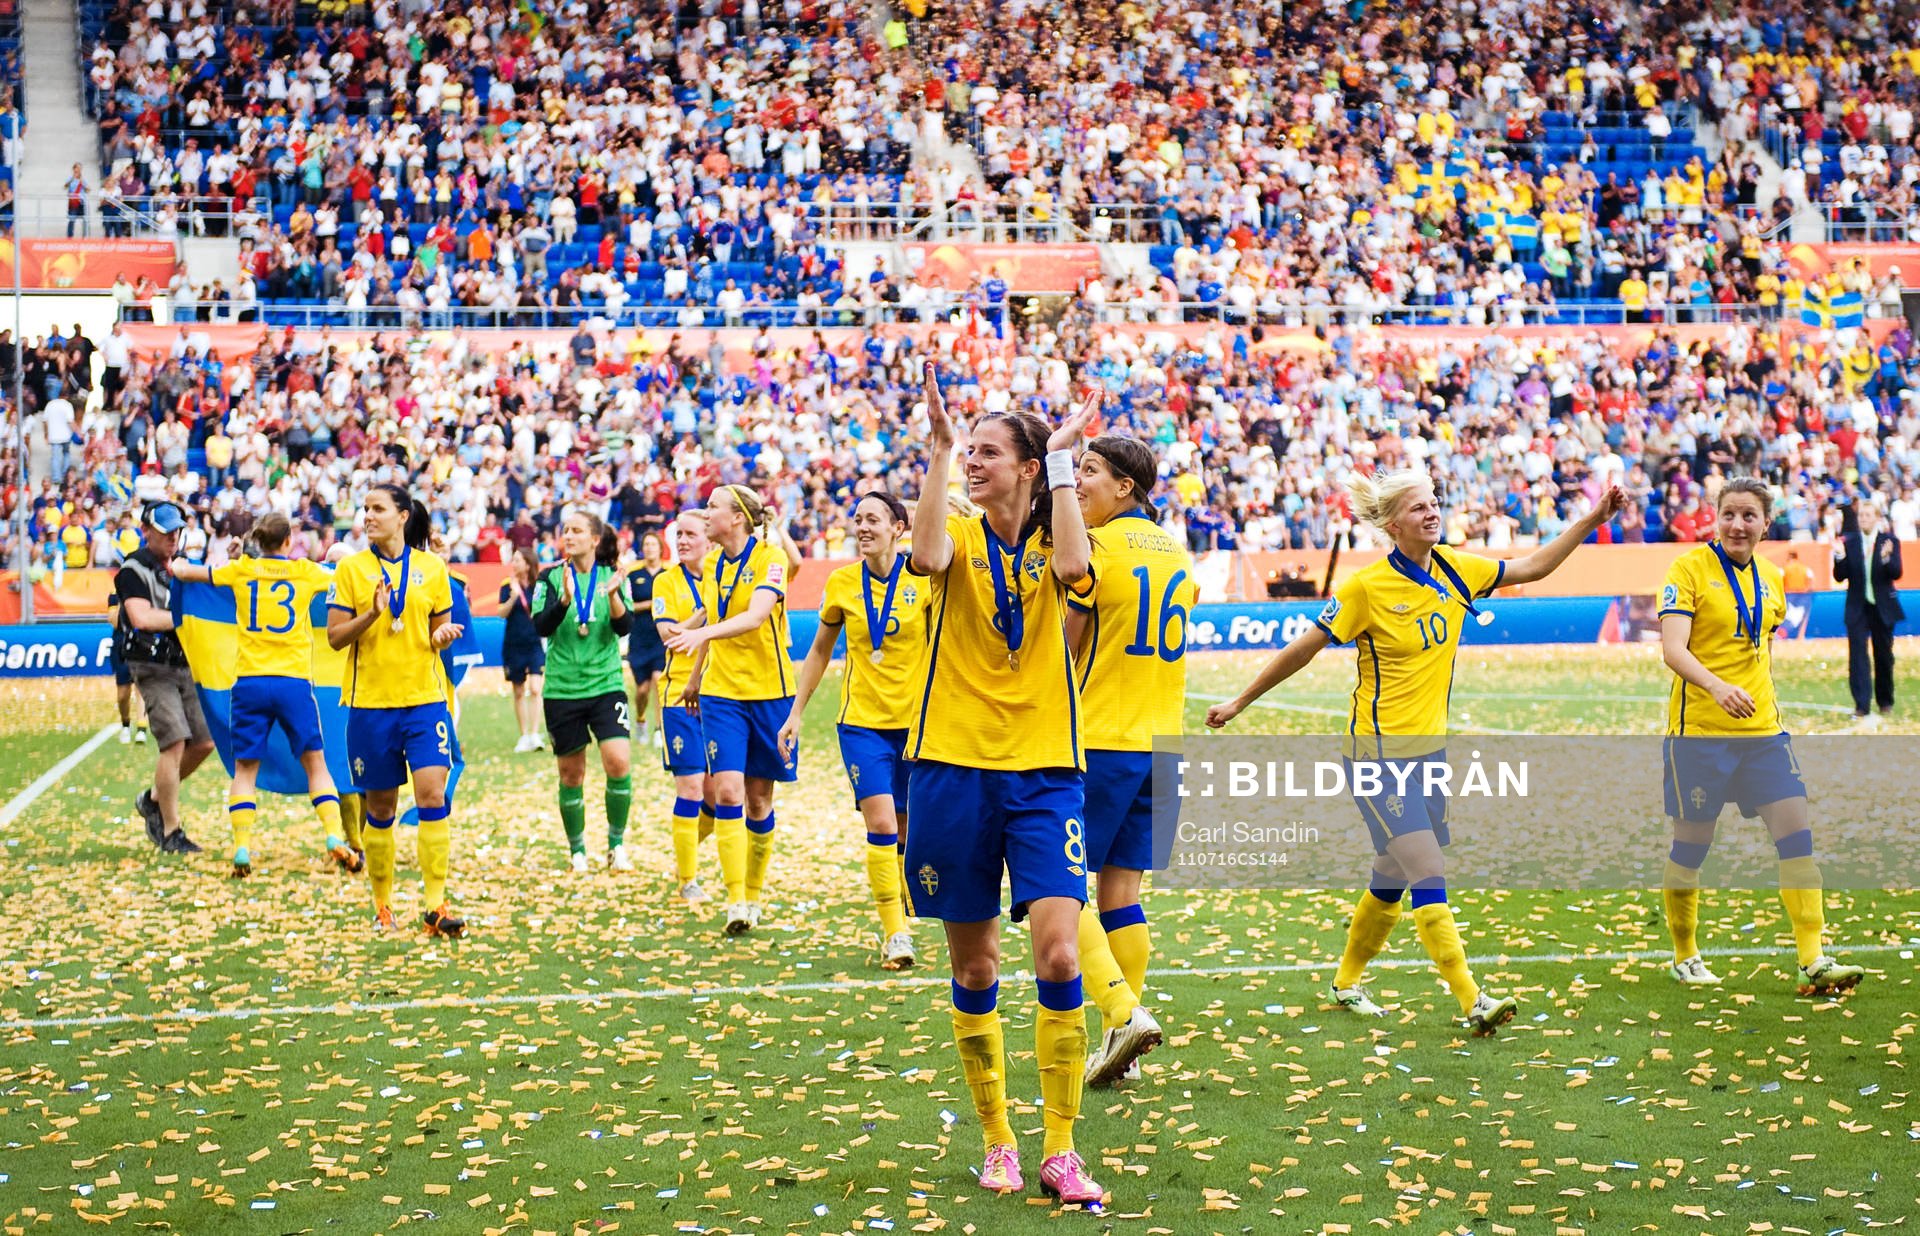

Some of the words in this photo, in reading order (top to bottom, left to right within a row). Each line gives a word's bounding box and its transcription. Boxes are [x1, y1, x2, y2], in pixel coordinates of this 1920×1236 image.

[1125, 532, 1181, 554] FORSBER
[246, 579, 296, 634] 13
[1125, 566, 1187, 663] 16
[1228, 615, 1279, 645] For
[1281, 612, 1317, 643] th
[1416, 611, 1447, 651] 10
[435, 720, 449, 748] 9
[1064, 818, 1084, 865] 8
